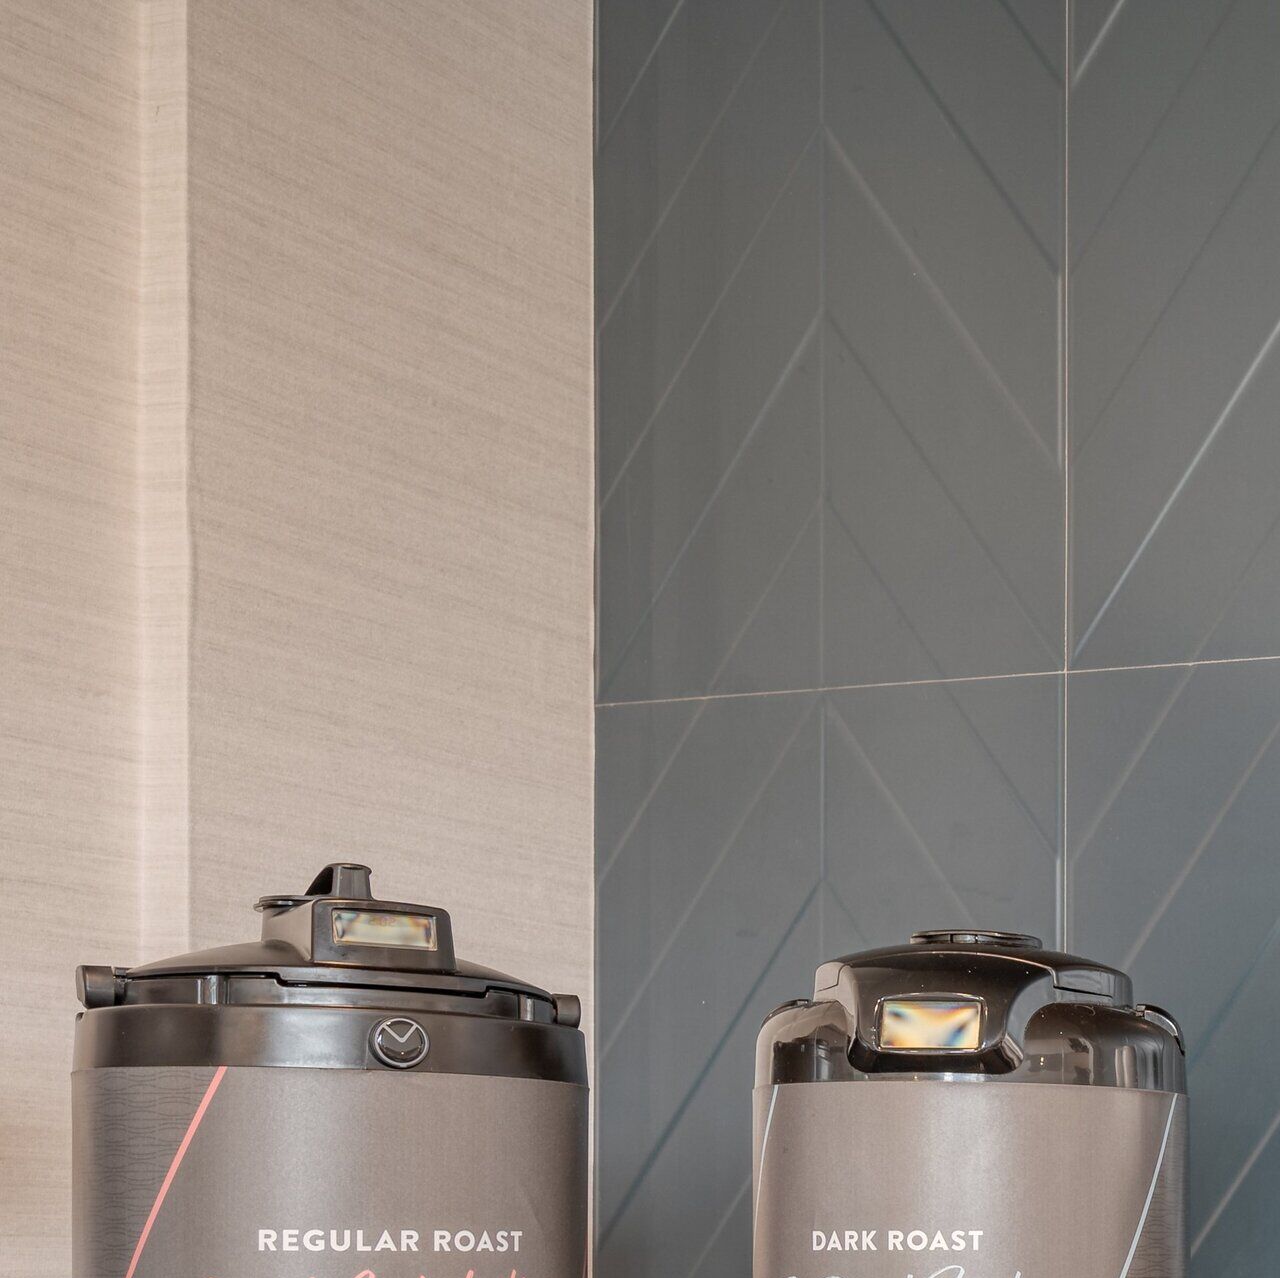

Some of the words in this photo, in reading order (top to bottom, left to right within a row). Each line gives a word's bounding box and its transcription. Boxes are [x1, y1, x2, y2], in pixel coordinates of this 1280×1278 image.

[258, 1229, 420, 1251] REGULAR
[433, 1230, 523, 1252] ROAST
[811, 1230, 878, 1251] DARK
[887, 1230, 984, 1251] ROAST
